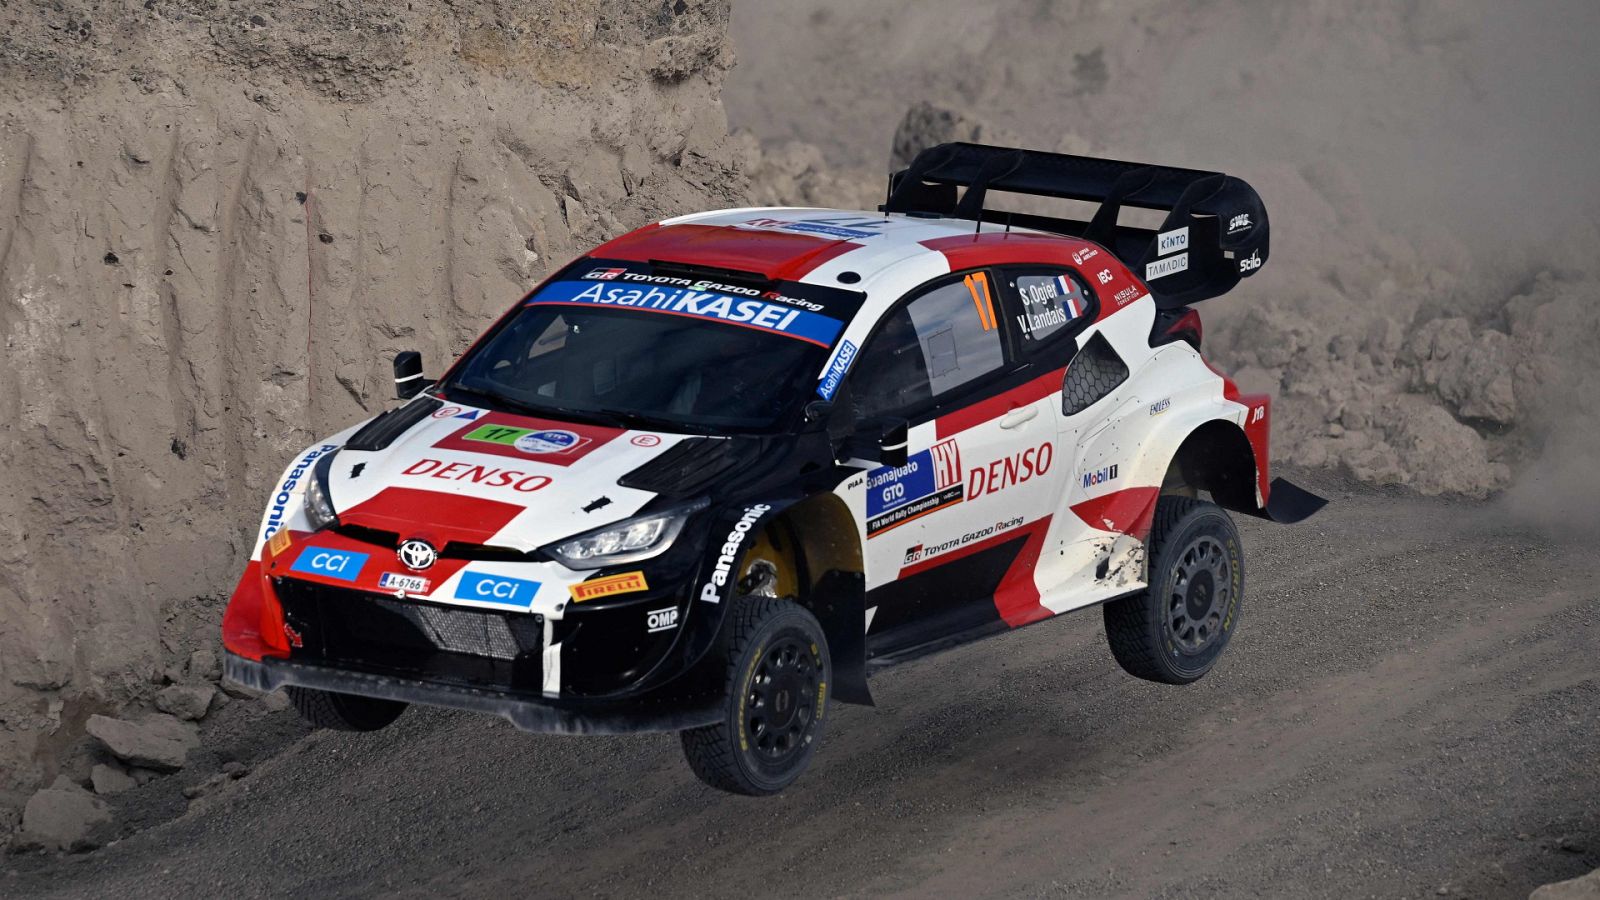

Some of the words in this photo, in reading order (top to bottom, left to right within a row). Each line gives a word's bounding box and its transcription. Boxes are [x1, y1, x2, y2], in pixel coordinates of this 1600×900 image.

[1229, 213, 1252, 231] SWS
[1148, 256, 1186, 277] TAMADIC
[1240, 248, 1261, 272] Stilo
[585, 272, 618, 280] GR
[624, 272, 692, 286] TOYOTA
[694, 280, 760, 297] GAZOO
[762, 291, 825, 312] Racing
[963, 271, 997, 331] 17
[1019, 282, 1058, 306] S.Ogier
[1114, 285, 1137, 301] NISULA
[574, 283, 800, 330] AsahiKASEI
[1016, 305, 1067, 334] V.Landais
[820, 340, 855, 399] AsahiKASEI
[1149, 398, 1171, 415] ENDLESS
[484, 428, 520, 440] 17
[401, 458, 553, 492] DENSO
[866, 461, 918, 489] Guanajuato
[931, 440, 961, 490] HY
[967, 442, 1053, 502] DENSO
[1083, 469, 1108, 488] Mobil
[264, 444, 338, 540] Panasonic
[847, 478, 863, 490] PIAA
[882, 482, 904, 503] GTO
[872, 522, 881, 531] FIA
[880, 515, 895, 526] World
[895, 508, 908, 520] Rally
[907, 497, 940, 514] Championship
[924, 538, 959, 557] TOYOTA
[961, 526, 994, 543] GAZOO
[995, 516, 1024, 532] Racing
[700, 504, 771, 604] Panasonic
[575, 574, 640, 598] PIRELLI
[648, 609, 678, 629] OMP
